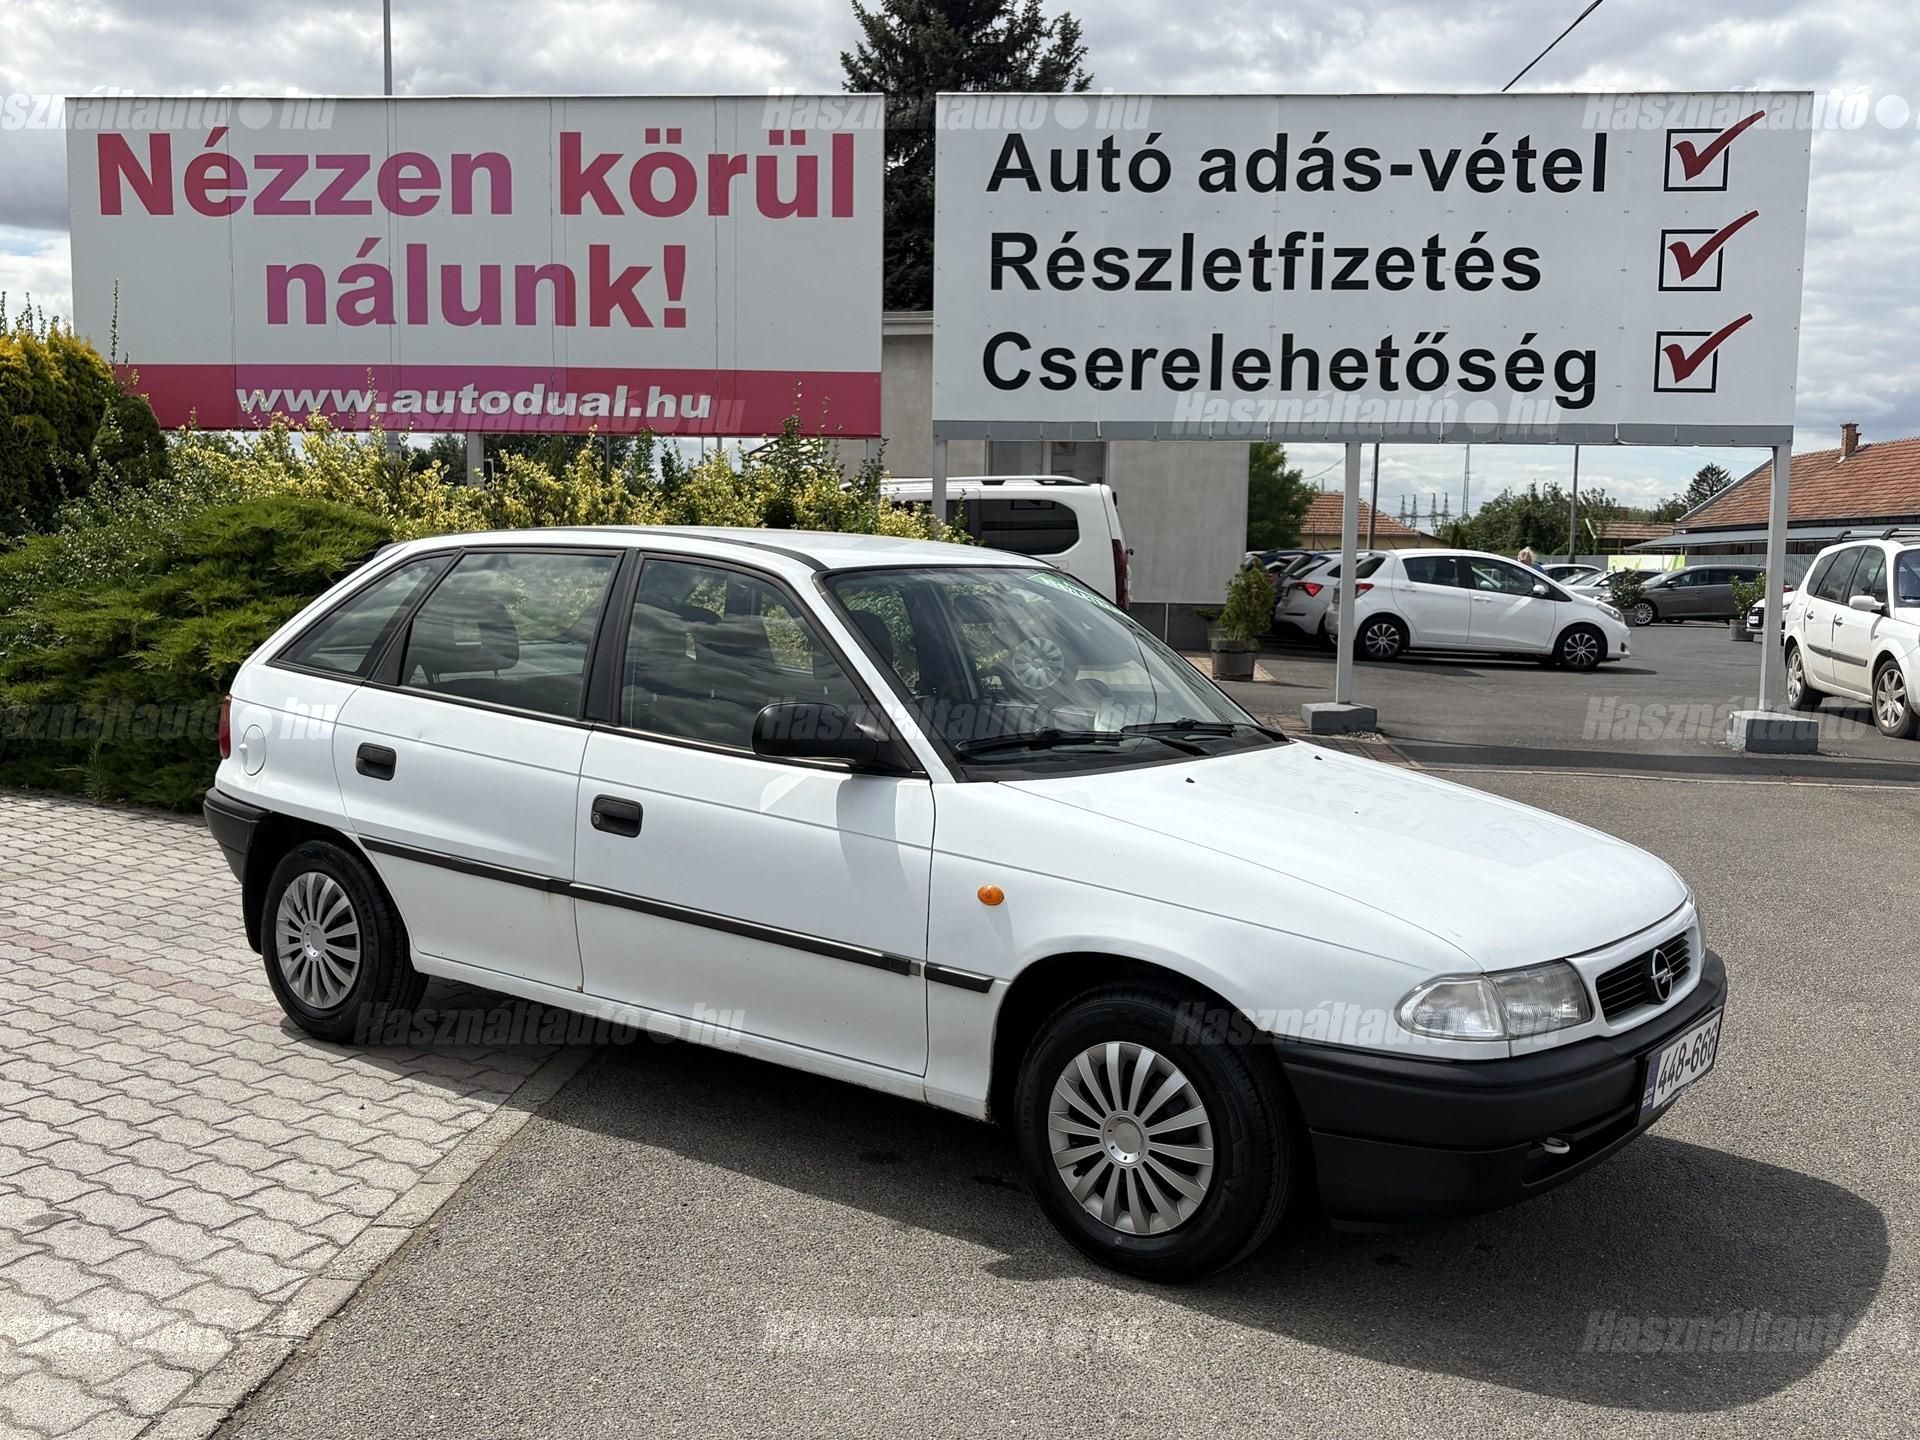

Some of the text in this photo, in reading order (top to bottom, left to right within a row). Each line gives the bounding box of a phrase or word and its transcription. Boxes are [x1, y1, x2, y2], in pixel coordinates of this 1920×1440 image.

[98, 127, 854, 219] Nézzen körül
[986, 131, 1608, 194] Autó adás-vétel
[267, 238, 686, 328] nálunk!
[990, 230, 1541, 292] Részletfizetés
[236, 383, 711, 420] www.autodual.hu
[982, 331, 1596, 410] Cserelehetőség
[1657, 1021, 1718, 1095] 448-666
